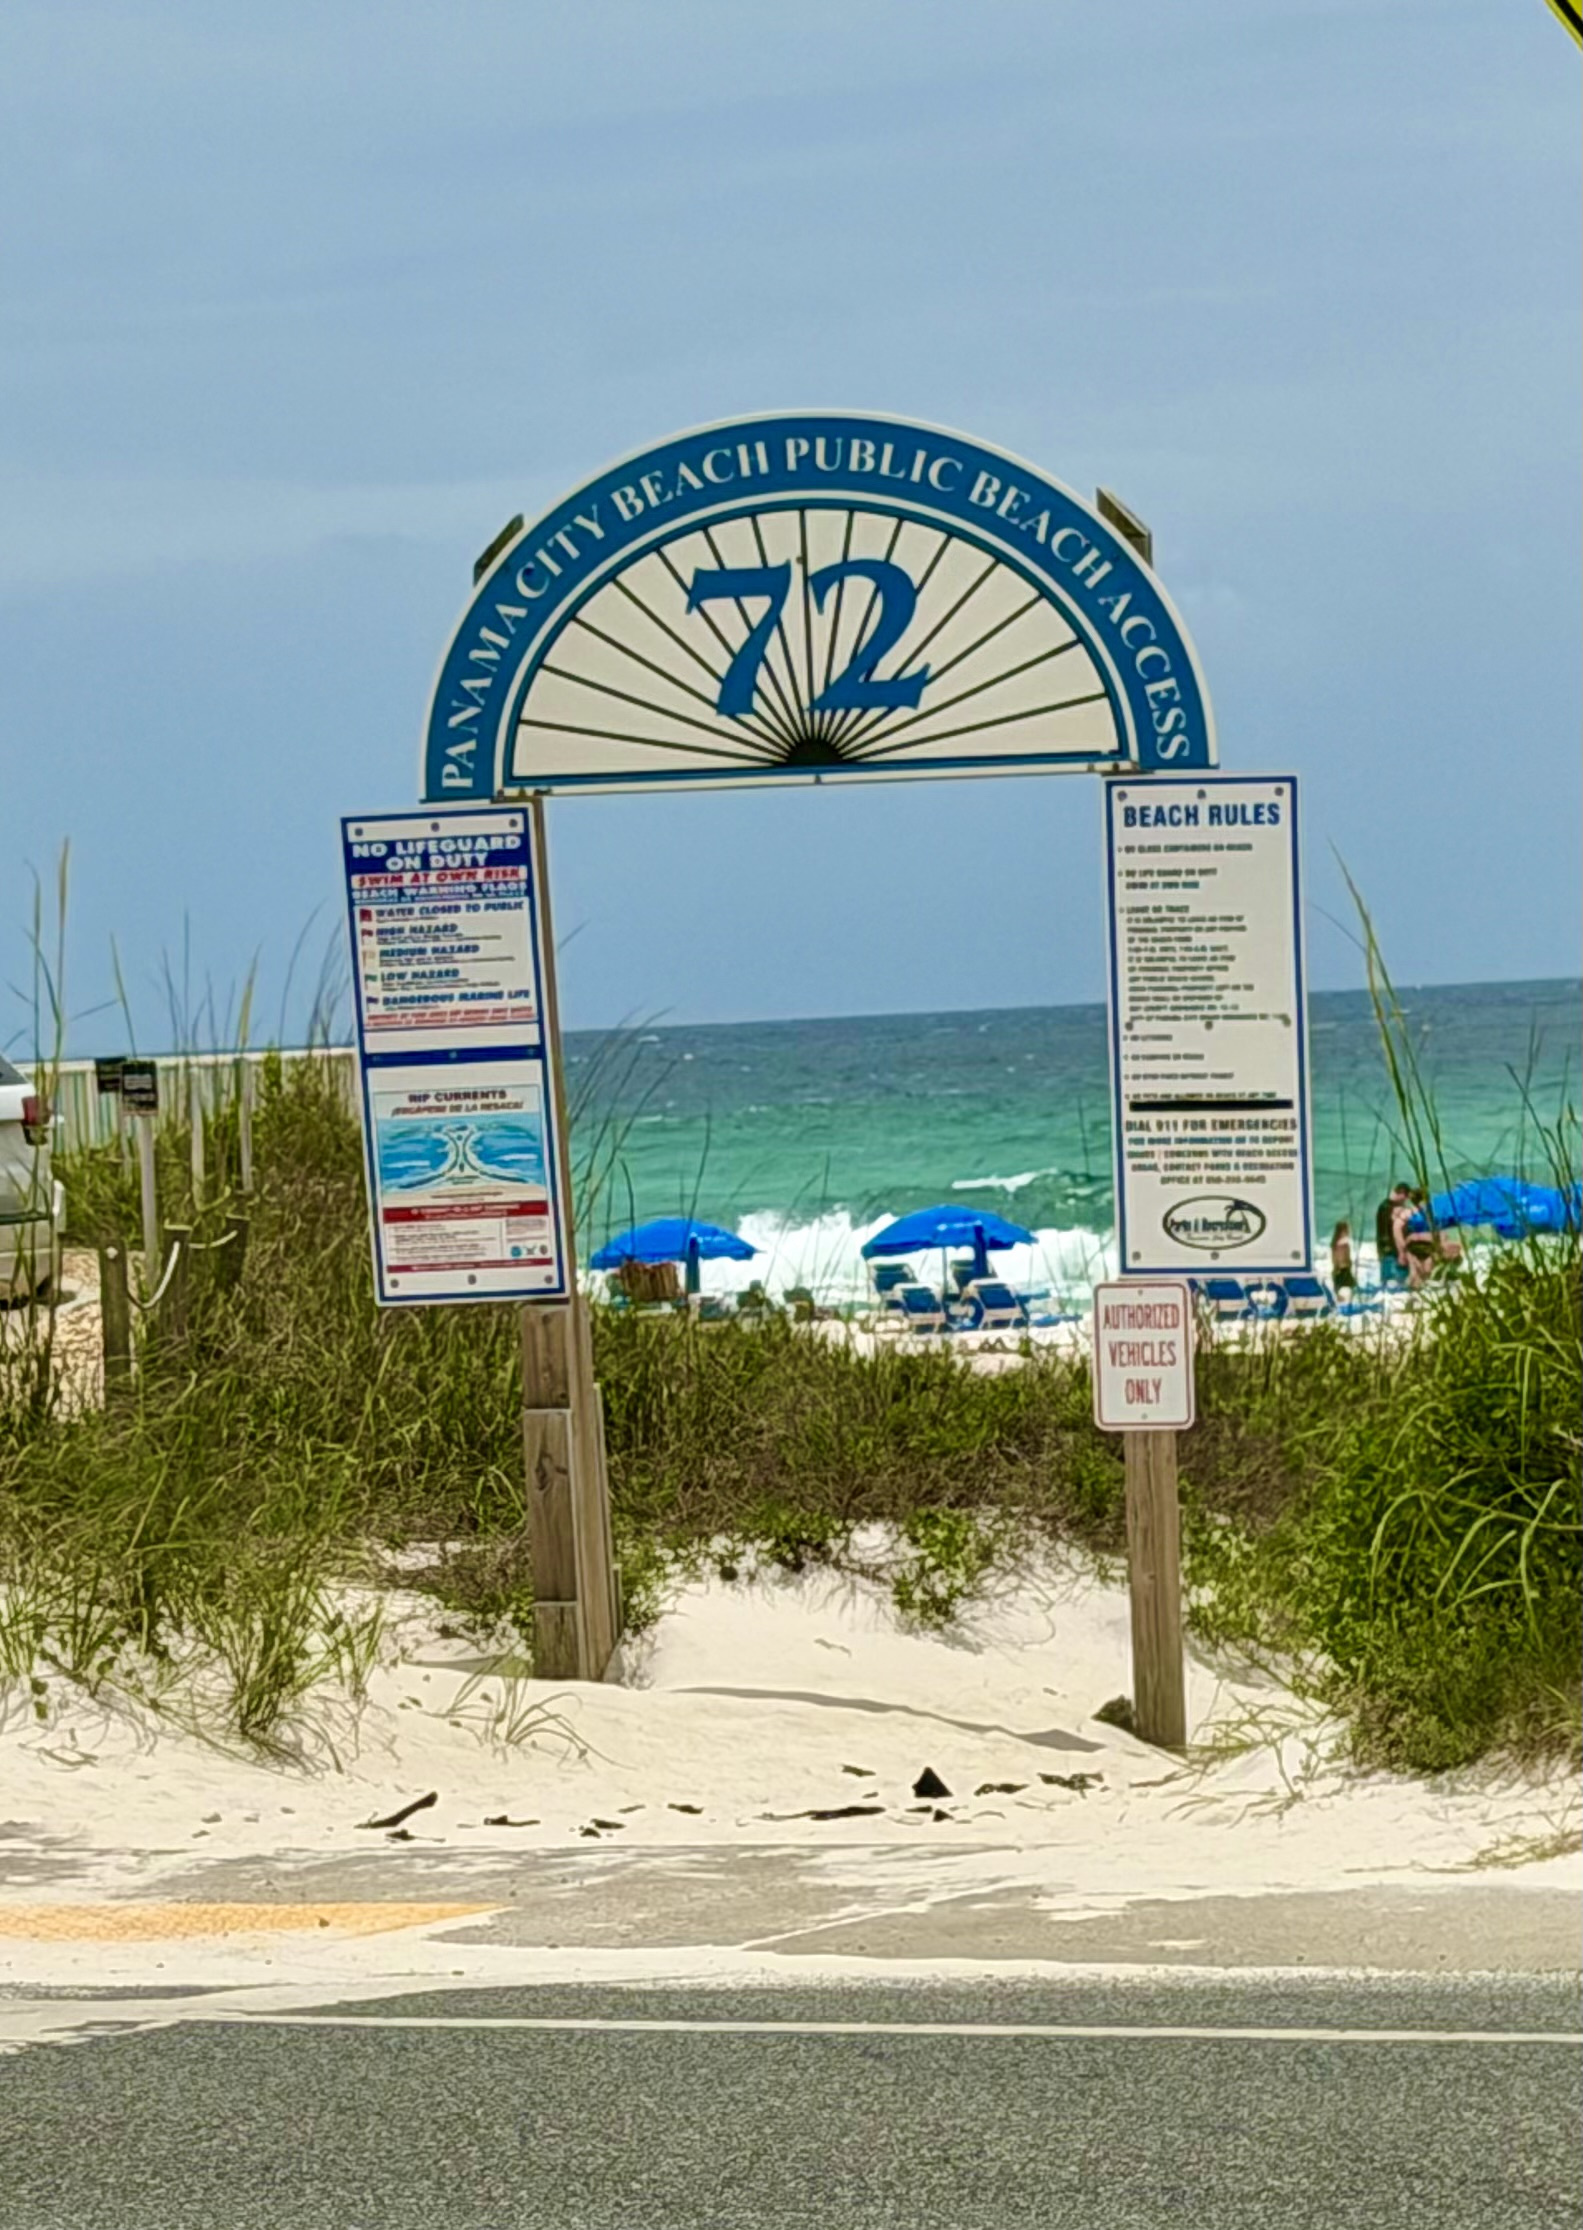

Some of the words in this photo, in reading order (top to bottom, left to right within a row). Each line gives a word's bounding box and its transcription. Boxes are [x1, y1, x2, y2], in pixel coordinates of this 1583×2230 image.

[442, 603, 528, 788] PANAMA
[516, 503, 605, 599] CITY
[610, 441, 770, 522] BEACH
[785, 436, 963, 492] PUBLIC
[968, 470, 1113, 589] BEACH
[1098, 592, 1190, 760] ACCESS
[685, 558, 931, 716] 72
[1123, 804, 1199, 827] BEACH
[1208, 803, 1280, 826] RULES
[353, 843, 387, 858] NO
[396, 835, 521, 855] LIFEGUARD
[386, 856, 421, 871] ON
[430, 853, 487, 868] DUTY
[358, 874, 403, 887] SWIM
[410, 872, 430, 884] AT
[436, 870, 478, 882] OWN
[484, 868, 519, 879] RISK
[434, 1090, 507, 1103] CURRENTS
[1125, 1120, 1151, 1132] DIAL
[1156, 1120, 1178, 1131] 911
[1183, 1119, 1207, 1131] FOR
[1211, 1118, 1297, 1131] EMERGENCIES
[1103, 1303, 1180, 1330] AUTHORIZED
[1108, 1341, 1177, 1367] VEHICLES
[1125, 1378, 1162, 1405] ONLY
